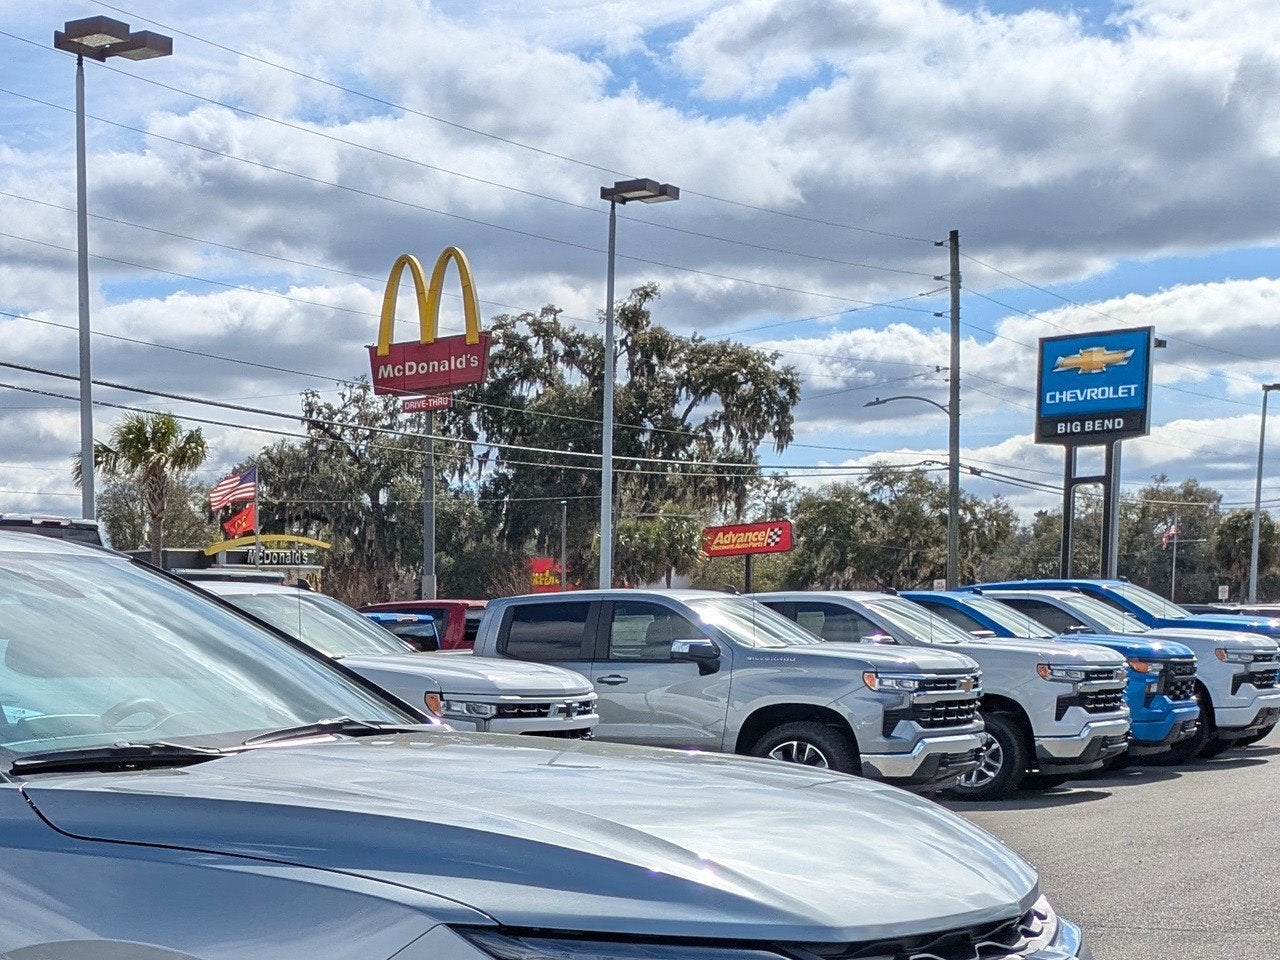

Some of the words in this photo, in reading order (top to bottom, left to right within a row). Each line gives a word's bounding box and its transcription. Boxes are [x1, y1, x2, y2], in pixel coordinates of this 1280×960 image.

[378, 353, 479, 379] McDonald's
[1045, 384, 1138, 404] CHEVROLET
[404, 395, 449, 410] DRIVE-THRU
[1057, 421, 1081, 434] BIG
[1084, 418, 1124, 432] BEND
[712, 530, 766, 545] Advance
[247, 550, 309, 564] McDonald's
